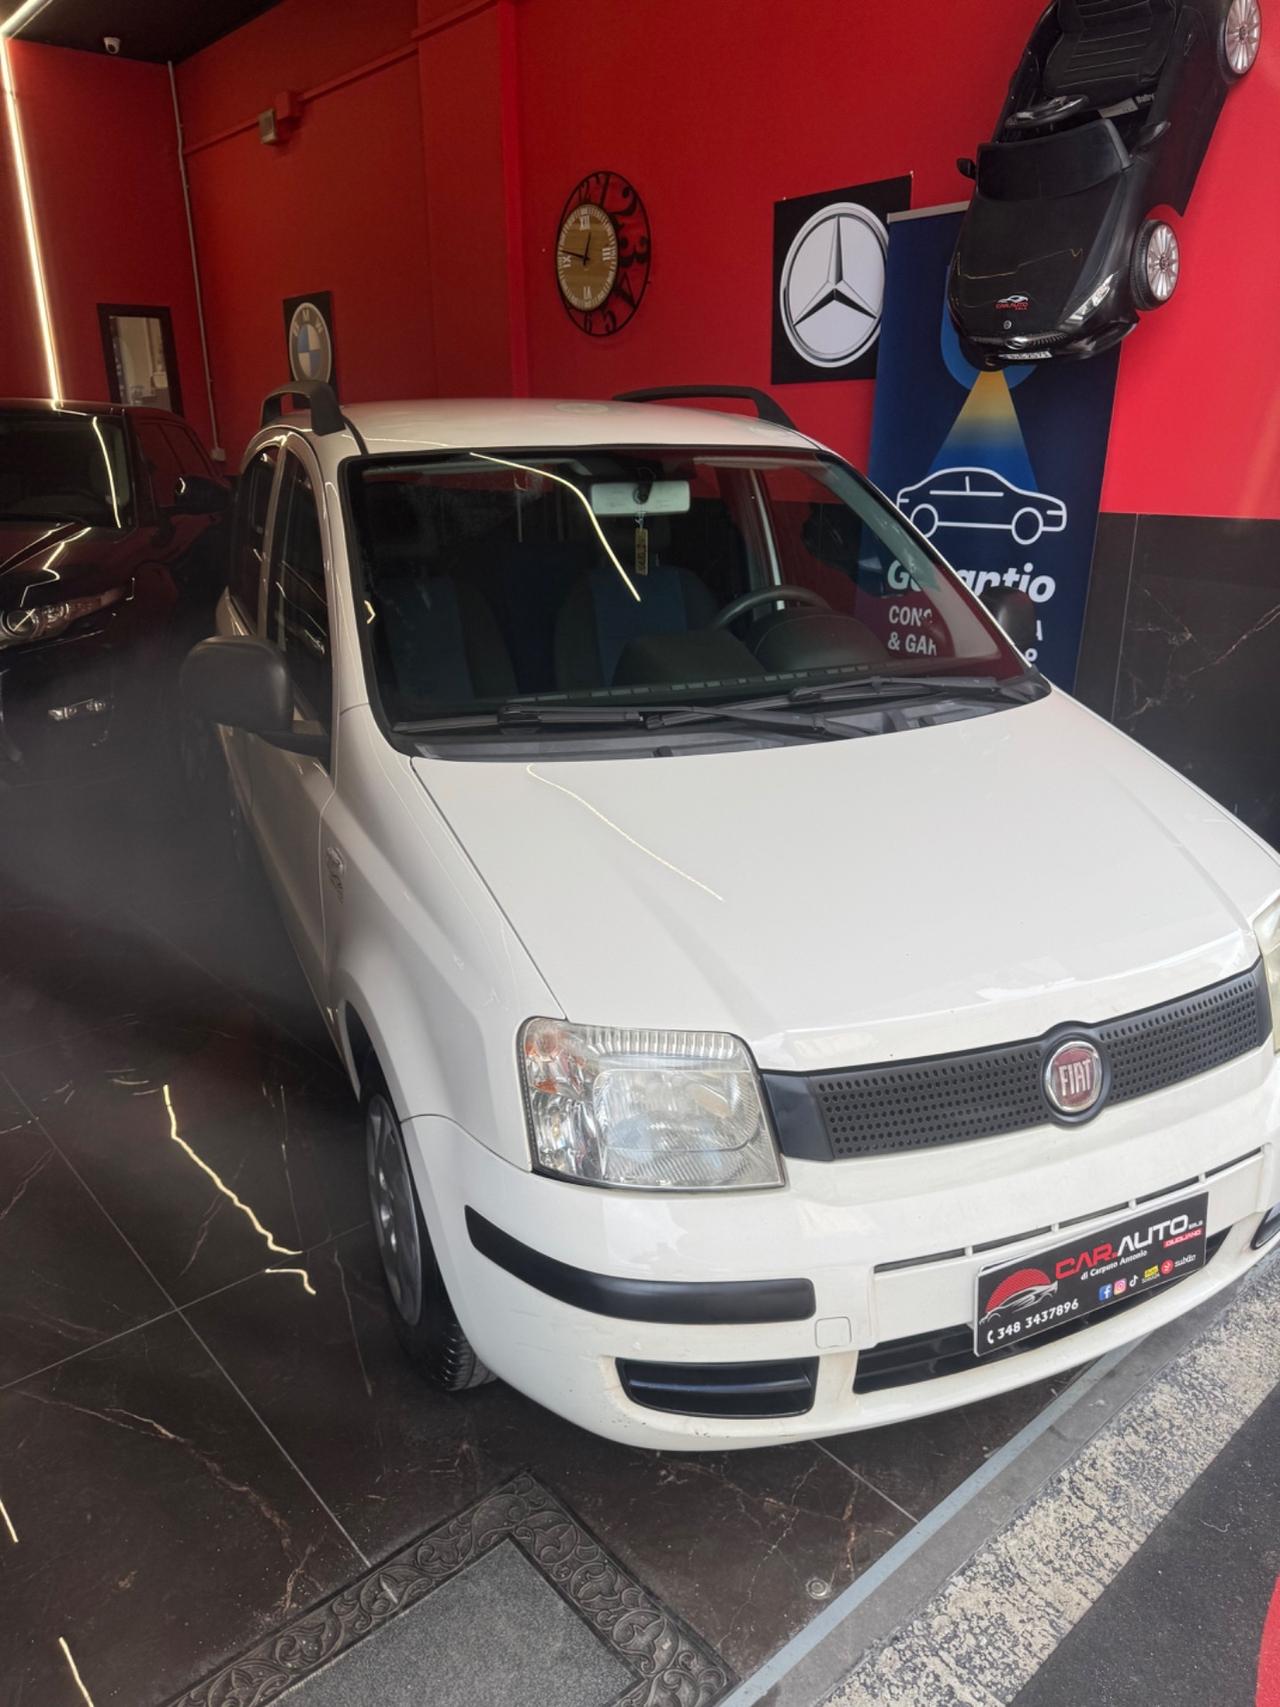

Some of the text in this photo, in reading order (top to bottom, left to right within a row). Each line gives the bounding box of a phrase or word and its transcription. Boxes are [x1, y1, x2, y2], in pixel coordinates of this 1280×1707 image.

[887, 560, 1056, 603] Gantio
[1058, 1059, 1091, 1097] FIAT
[1119, 1249, 1148, 1266] Antonio
[997, 1298, 1079, 1340] 348 3437896
